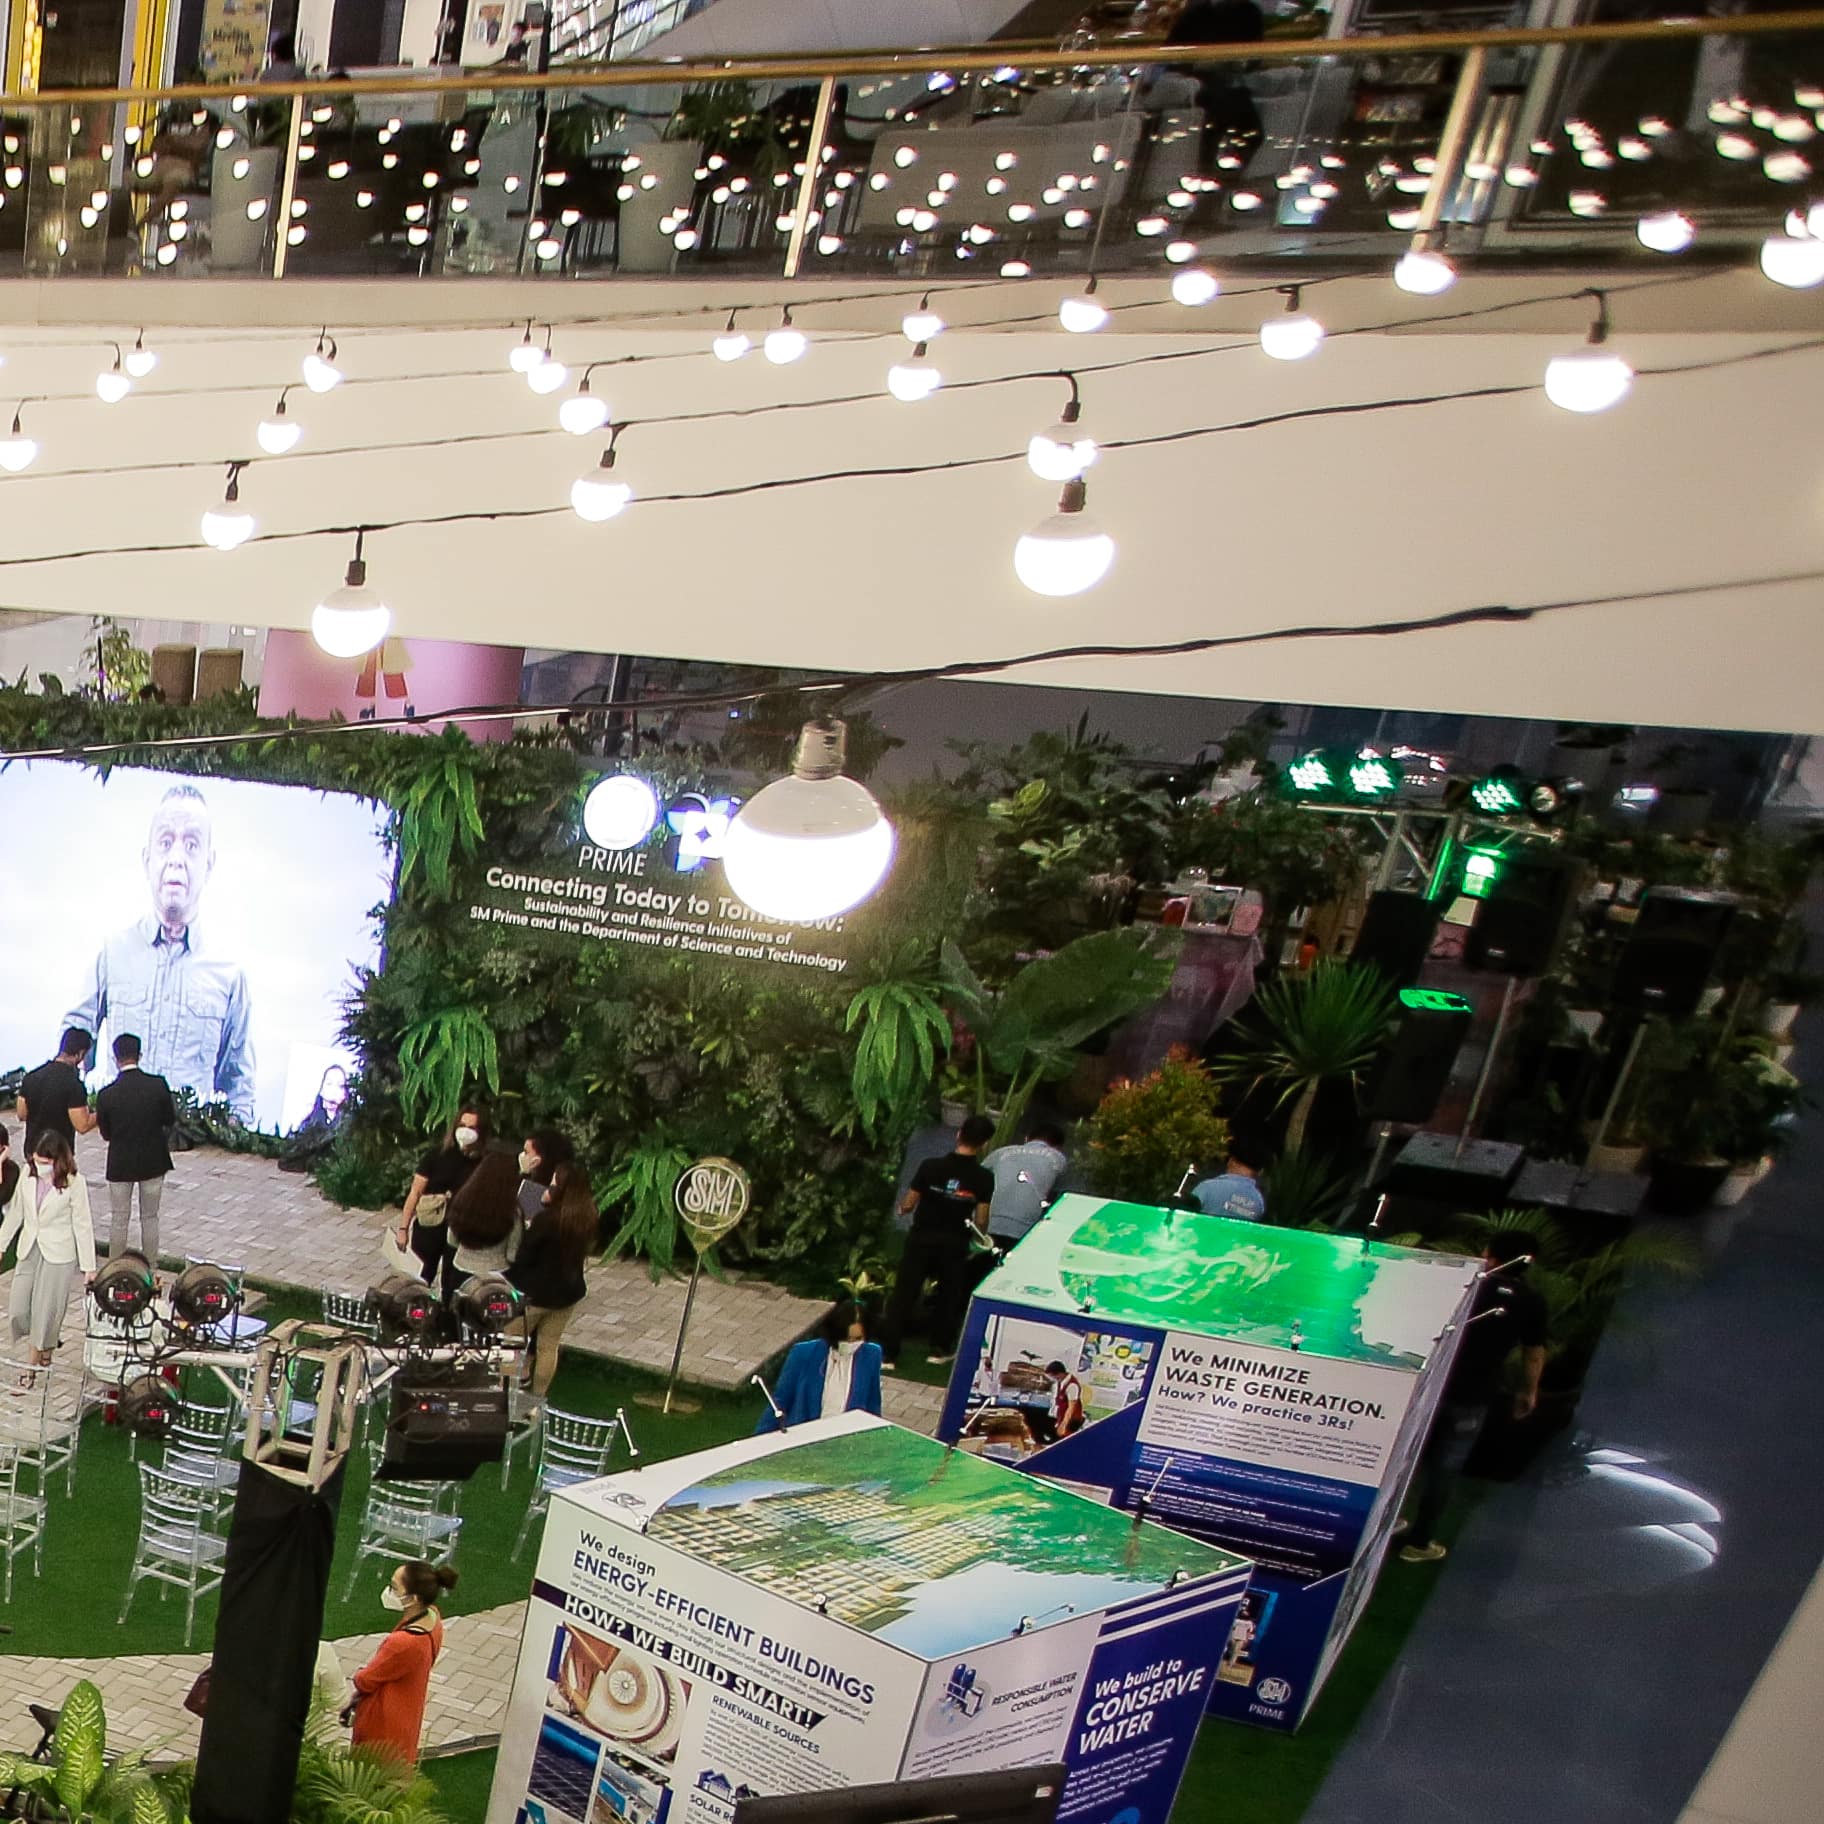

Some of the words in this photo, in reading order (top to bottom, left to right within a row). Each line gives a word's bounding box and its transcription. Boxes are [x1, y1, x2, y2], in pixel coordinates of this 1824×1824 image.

[578, 845, 648, 877] PRIME
[486, 867, 608, 905] Connecting
[613, 882, 682, 916] Today
[687, 892, 711, 917] to
[470, 905, 491, 921] SM
[493, 909, 528, 926] Prime
[531, 917, 557, 930] and
[559, 918, 580, 933] the
[582, 922, 662, 945] Department
[663, 934, 680, 948] of
[680, 937, 734, 956] Science
[735, 945, 764, 960] and
[767, 947, 848, 972] Technology
[524, 897, 610, 923] Sustainability
[611, 912, 638, 926] and
[640, 912, 705, 934] Resilience
[708, 921, 773, 943] Initiatives
[776, 932, 795, 945] of
[683, 1167, 736, 1217] SM
[1170, 1347, 1204, 1366] We
[1210, 1354, 1311, 1385] MINIMIZE
[1158, 1385, 1206, 1402] How?
[1212, 1393, 1238, 1410] We
[1242, 1401, 1313, 1424] practice
[1317, 1413, 1354, 1431] 3Rs!
[1165, 1366, 1237, 1392] WASTE
[1243, 1382, 1386, 1420] GENERATION.
[580, 1529, 603, 1551] We
[607, 1545, 657, 1576] design
[573, 1550, 755, 1649] ENERGY-EFFICIENT
[758, 1637, 875, 1705] BUILDINGS
[564, 1594, 627, 1637] HOW?
[631, 1626, 667, 1655] WE
[670, 1643, 728, 1685] BUILD
[732, 1677, 814, 1729] SMART!
[1095, 1677, 1120, 1699] We
[1123, 1664, 1162, 1688] build
[1161, 1659, 1182, 1675] to
[992, 1681, 1047, 1706] RESPONSIBLE
[1049, 1672, 1078, 1688] WATER
[1011, 1686, 1074, 1713] CONSUMPTION
[1086, 1667, 1205, 1727] CONSERVE
[1248, 1703, 1285, 1721] PRIME
[1258, 1679, 1290, 1703] SM
[712, 1695, 771, 1732] RENEWABLE
[773, 1724, 821, 1755] SOURCES
[1079, 1711, 1153, 1755] WATER
[689, 1793, 722, 1816] SOLAR
